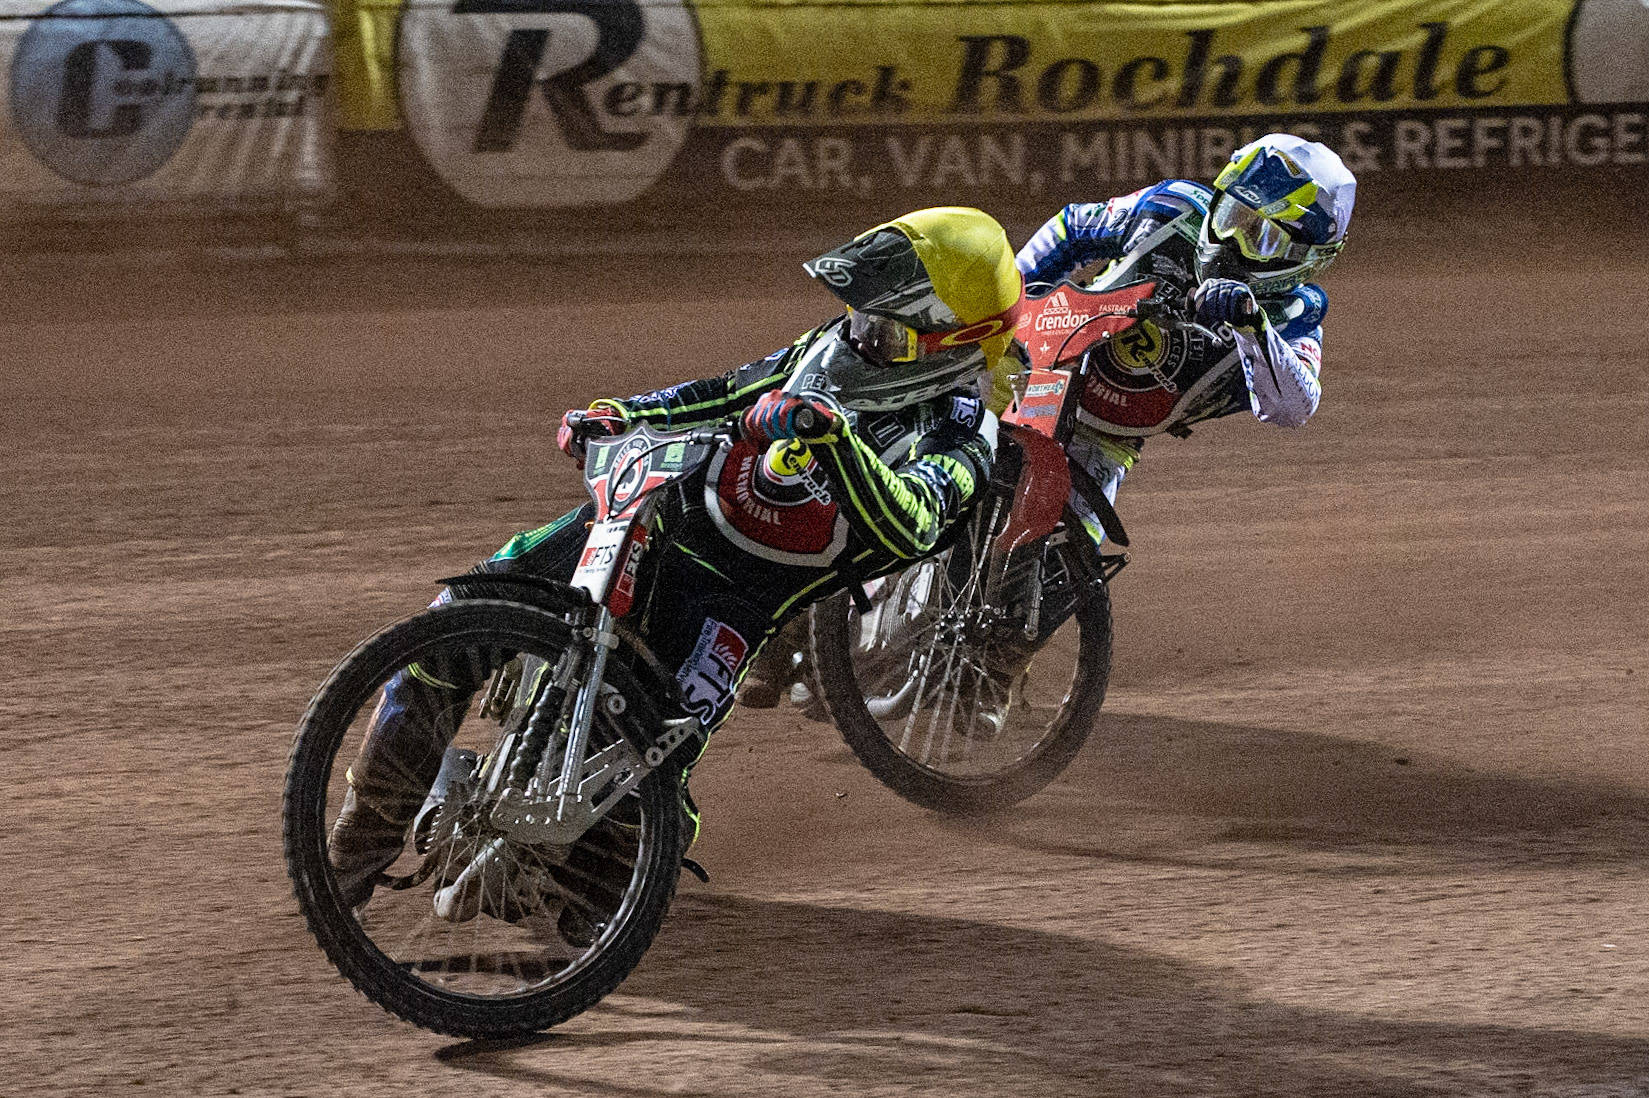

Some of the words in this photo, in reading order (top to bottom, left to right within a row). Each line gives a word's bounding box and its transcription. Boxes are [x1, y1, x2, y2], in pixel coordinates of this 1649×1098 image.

[453, 0, 913, 152] Rentruck
[948, 22, 1512, 113] Rochdale
[721, 136, 872, 193] CAR,
[885, 133, 1045, 193] VAN,
[1342, 121, 1382, 171] &
[1035, 309, 1089, 332] Crendon
[594, 543, 617, 565] FTS
